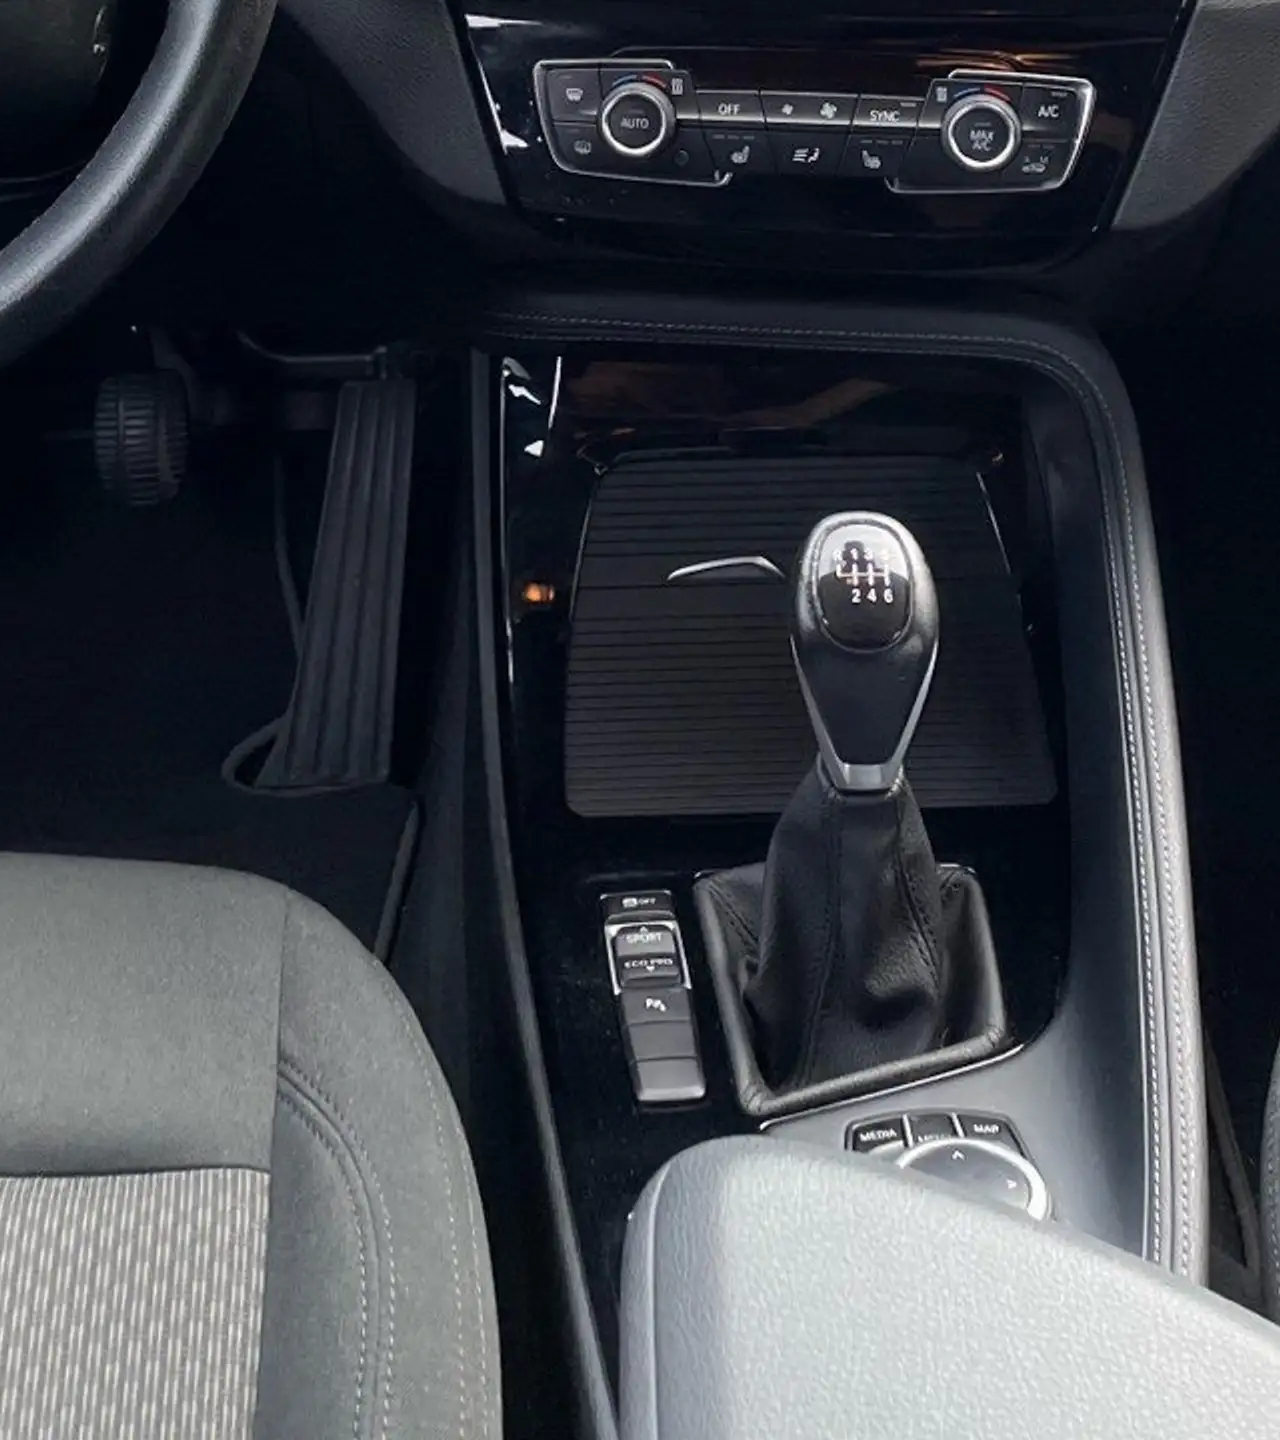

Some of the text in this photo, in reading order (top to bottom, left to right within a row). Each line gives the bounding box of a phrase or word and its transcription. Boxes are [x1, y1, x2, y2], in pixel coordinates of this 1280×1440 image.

[717, 102, 741, 116] OFF
[869, 109, 901, 123] SYNC
[1037, 105, 1060, 119] A/C
[619, 117, 650, 130] AUTO
[969, 129, 994, 142] MAX
[971, 139, 992, 152] A/C
[850, 547, 859, 561] 1
[851, 587, 894, 604] 2 4 6
[625, 931, 663, 945] SPORT
[623, 959, 649, 969] ECO
[859, 1127, 898, 1143] MEDIA
[972, 1123, 1000, 1135] MAP
